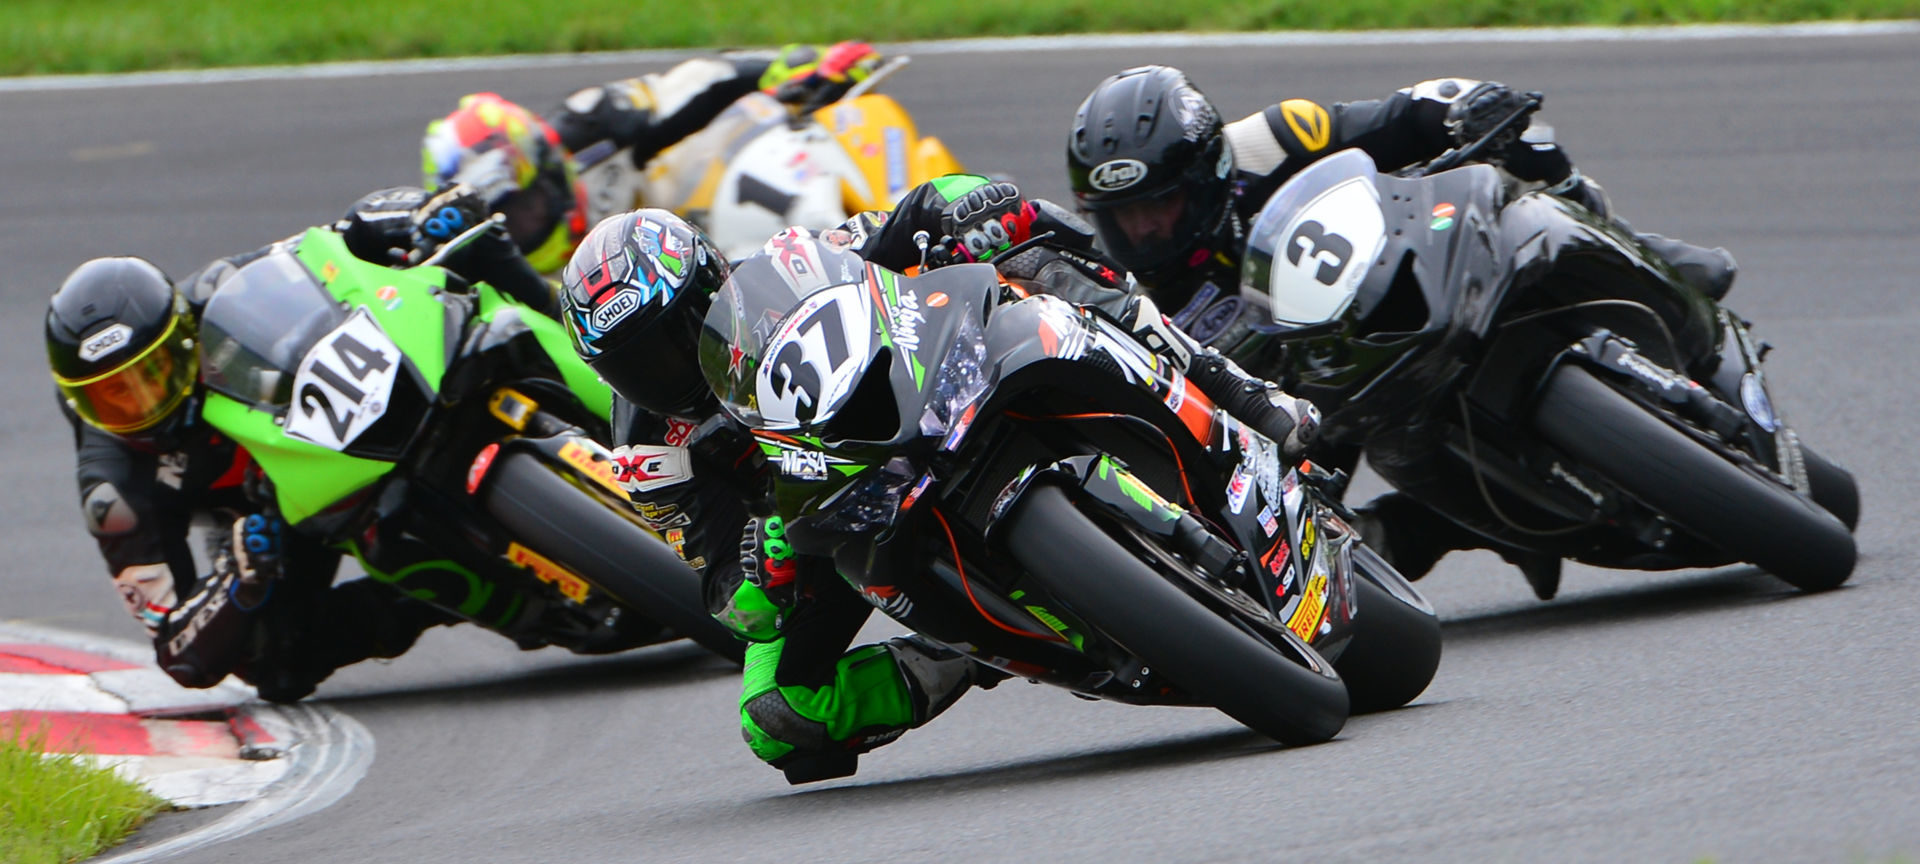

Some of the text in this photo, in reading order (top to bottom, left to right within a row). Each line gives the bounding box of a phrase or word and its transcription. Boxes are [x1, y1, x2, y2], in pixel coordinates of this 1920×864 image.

[1096, 164, 1138, 184] Arai
[1286, 219, 1353, 286] 3
[599, 294, 634, 327] SHOEI
[768, 307, 810, 362] MOTOAMERICA
[892, 289, 926, 351] Ninja
[300, 332, 392, 443] 214
[770, 298, 850, 428] 37
